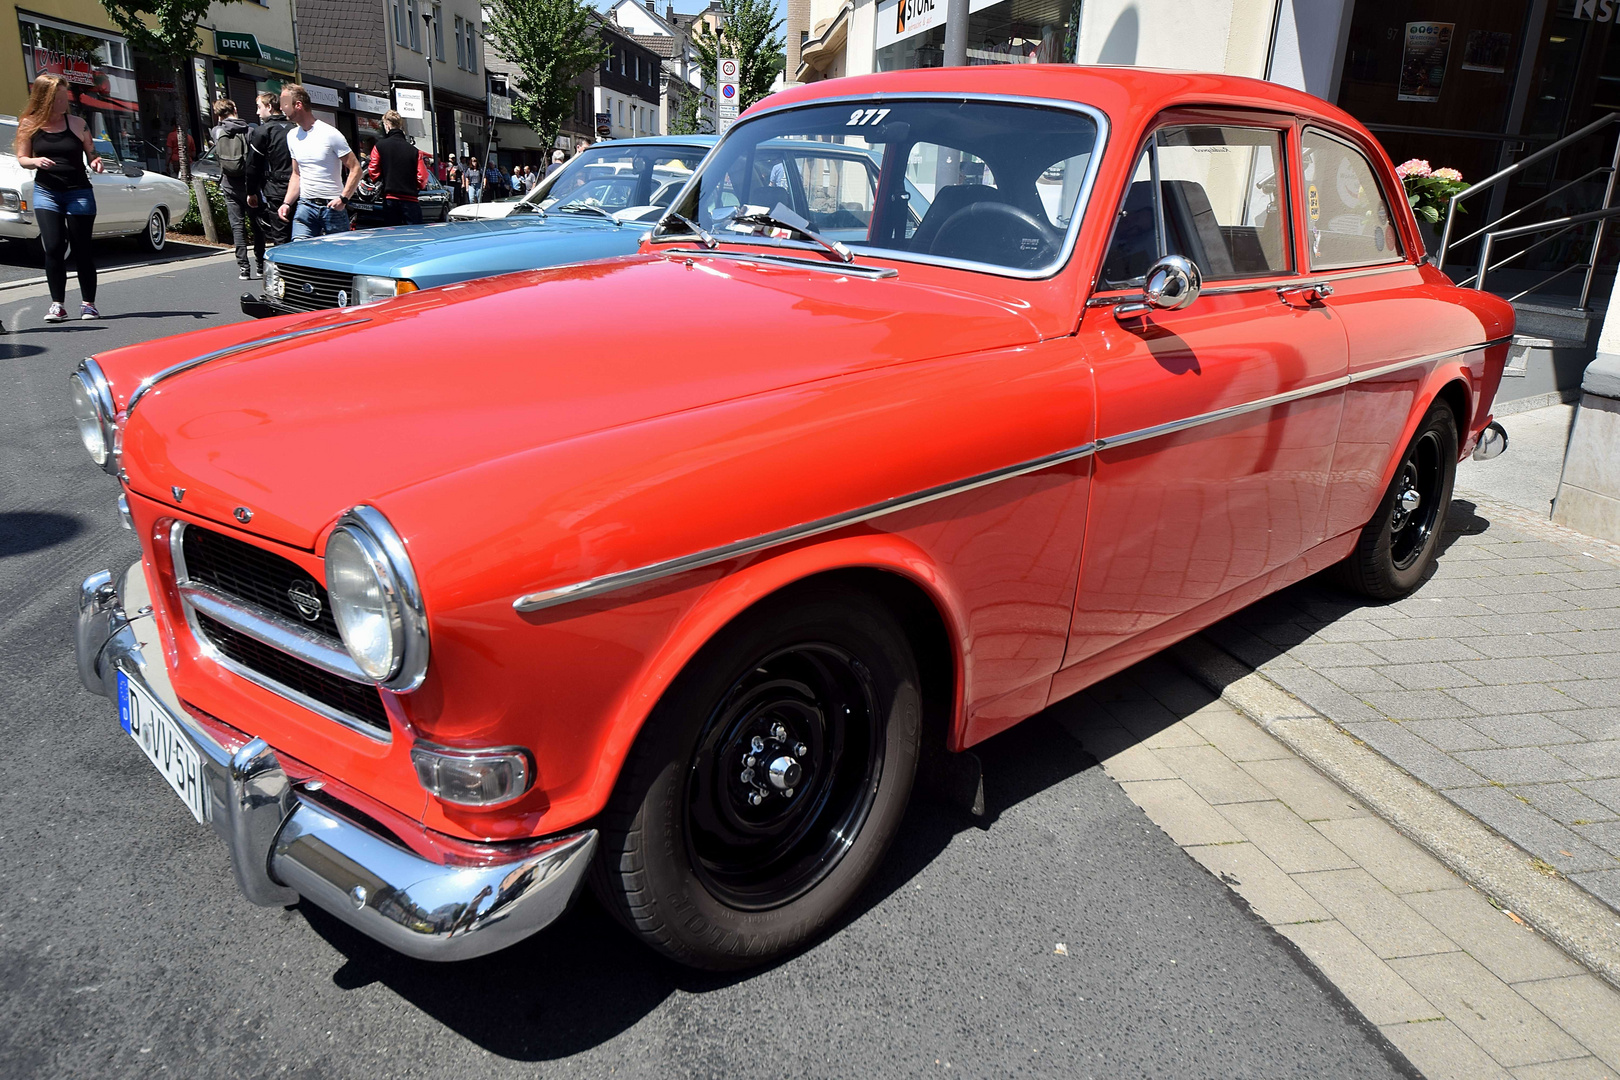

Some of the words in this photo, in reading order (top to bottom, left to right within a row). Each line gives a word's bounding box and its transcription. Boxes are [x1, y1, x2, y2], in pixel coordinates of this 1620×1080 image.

[1387, 27, 1399, 40] 97
[222, 38, 250, 50] DEVK
[846, 109, 890, 125] 277
[290, 593, 320, 609] VOLVO
[129, 688, 140, 736] D
